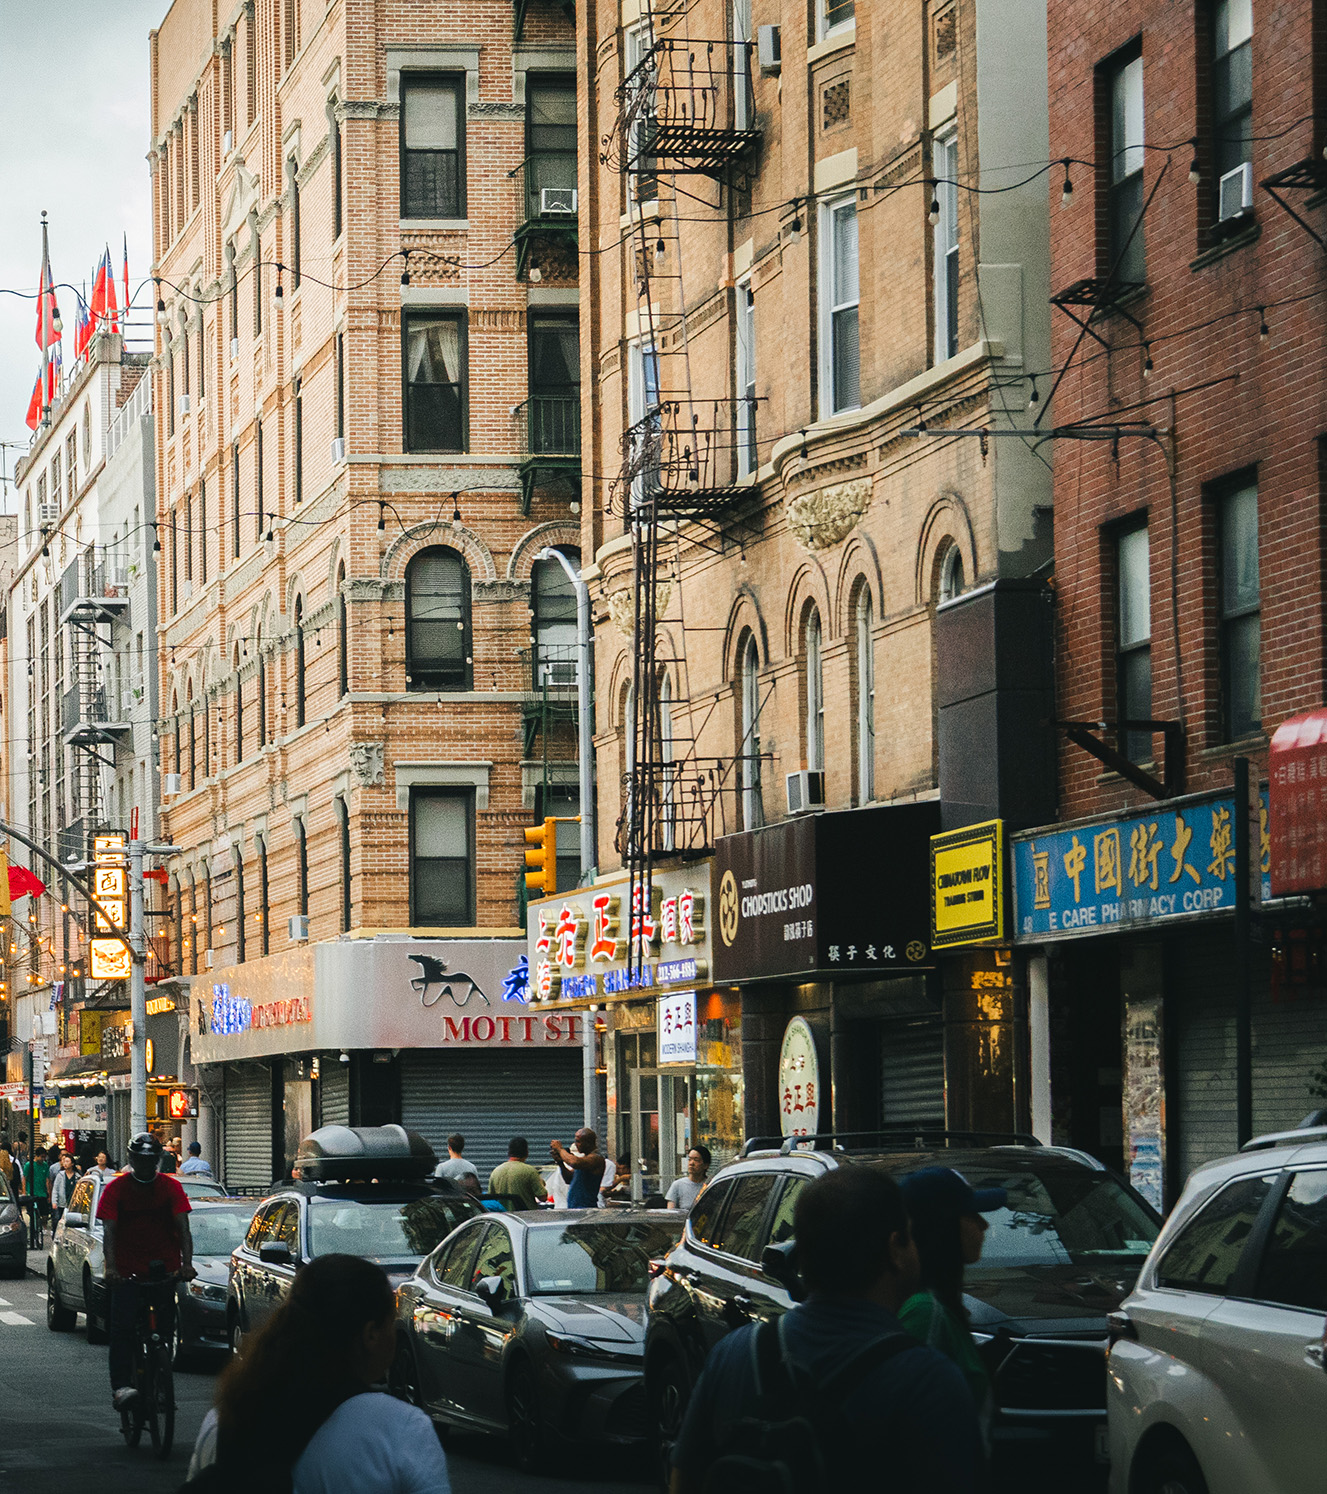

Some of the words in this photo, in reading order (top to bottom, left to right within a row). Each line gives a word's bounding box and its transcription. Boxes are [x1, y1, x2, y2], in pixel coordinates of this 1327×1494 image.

[973, 863, 991, 882] FLOW
[741, 888, 788, 918] CHOPSTICKS
[788, 883, 813, 911] SHOP
[1049, 911, 1057, 930] E
[1062, 905, 1097, 927] CARE
[1101, 893, 1177, 922] PHARMACY
[1183, 886, 1223, 911] CORP
[442, 1015, 538, 1042] MOTT
[544, 1014, 583, 1041] ST
